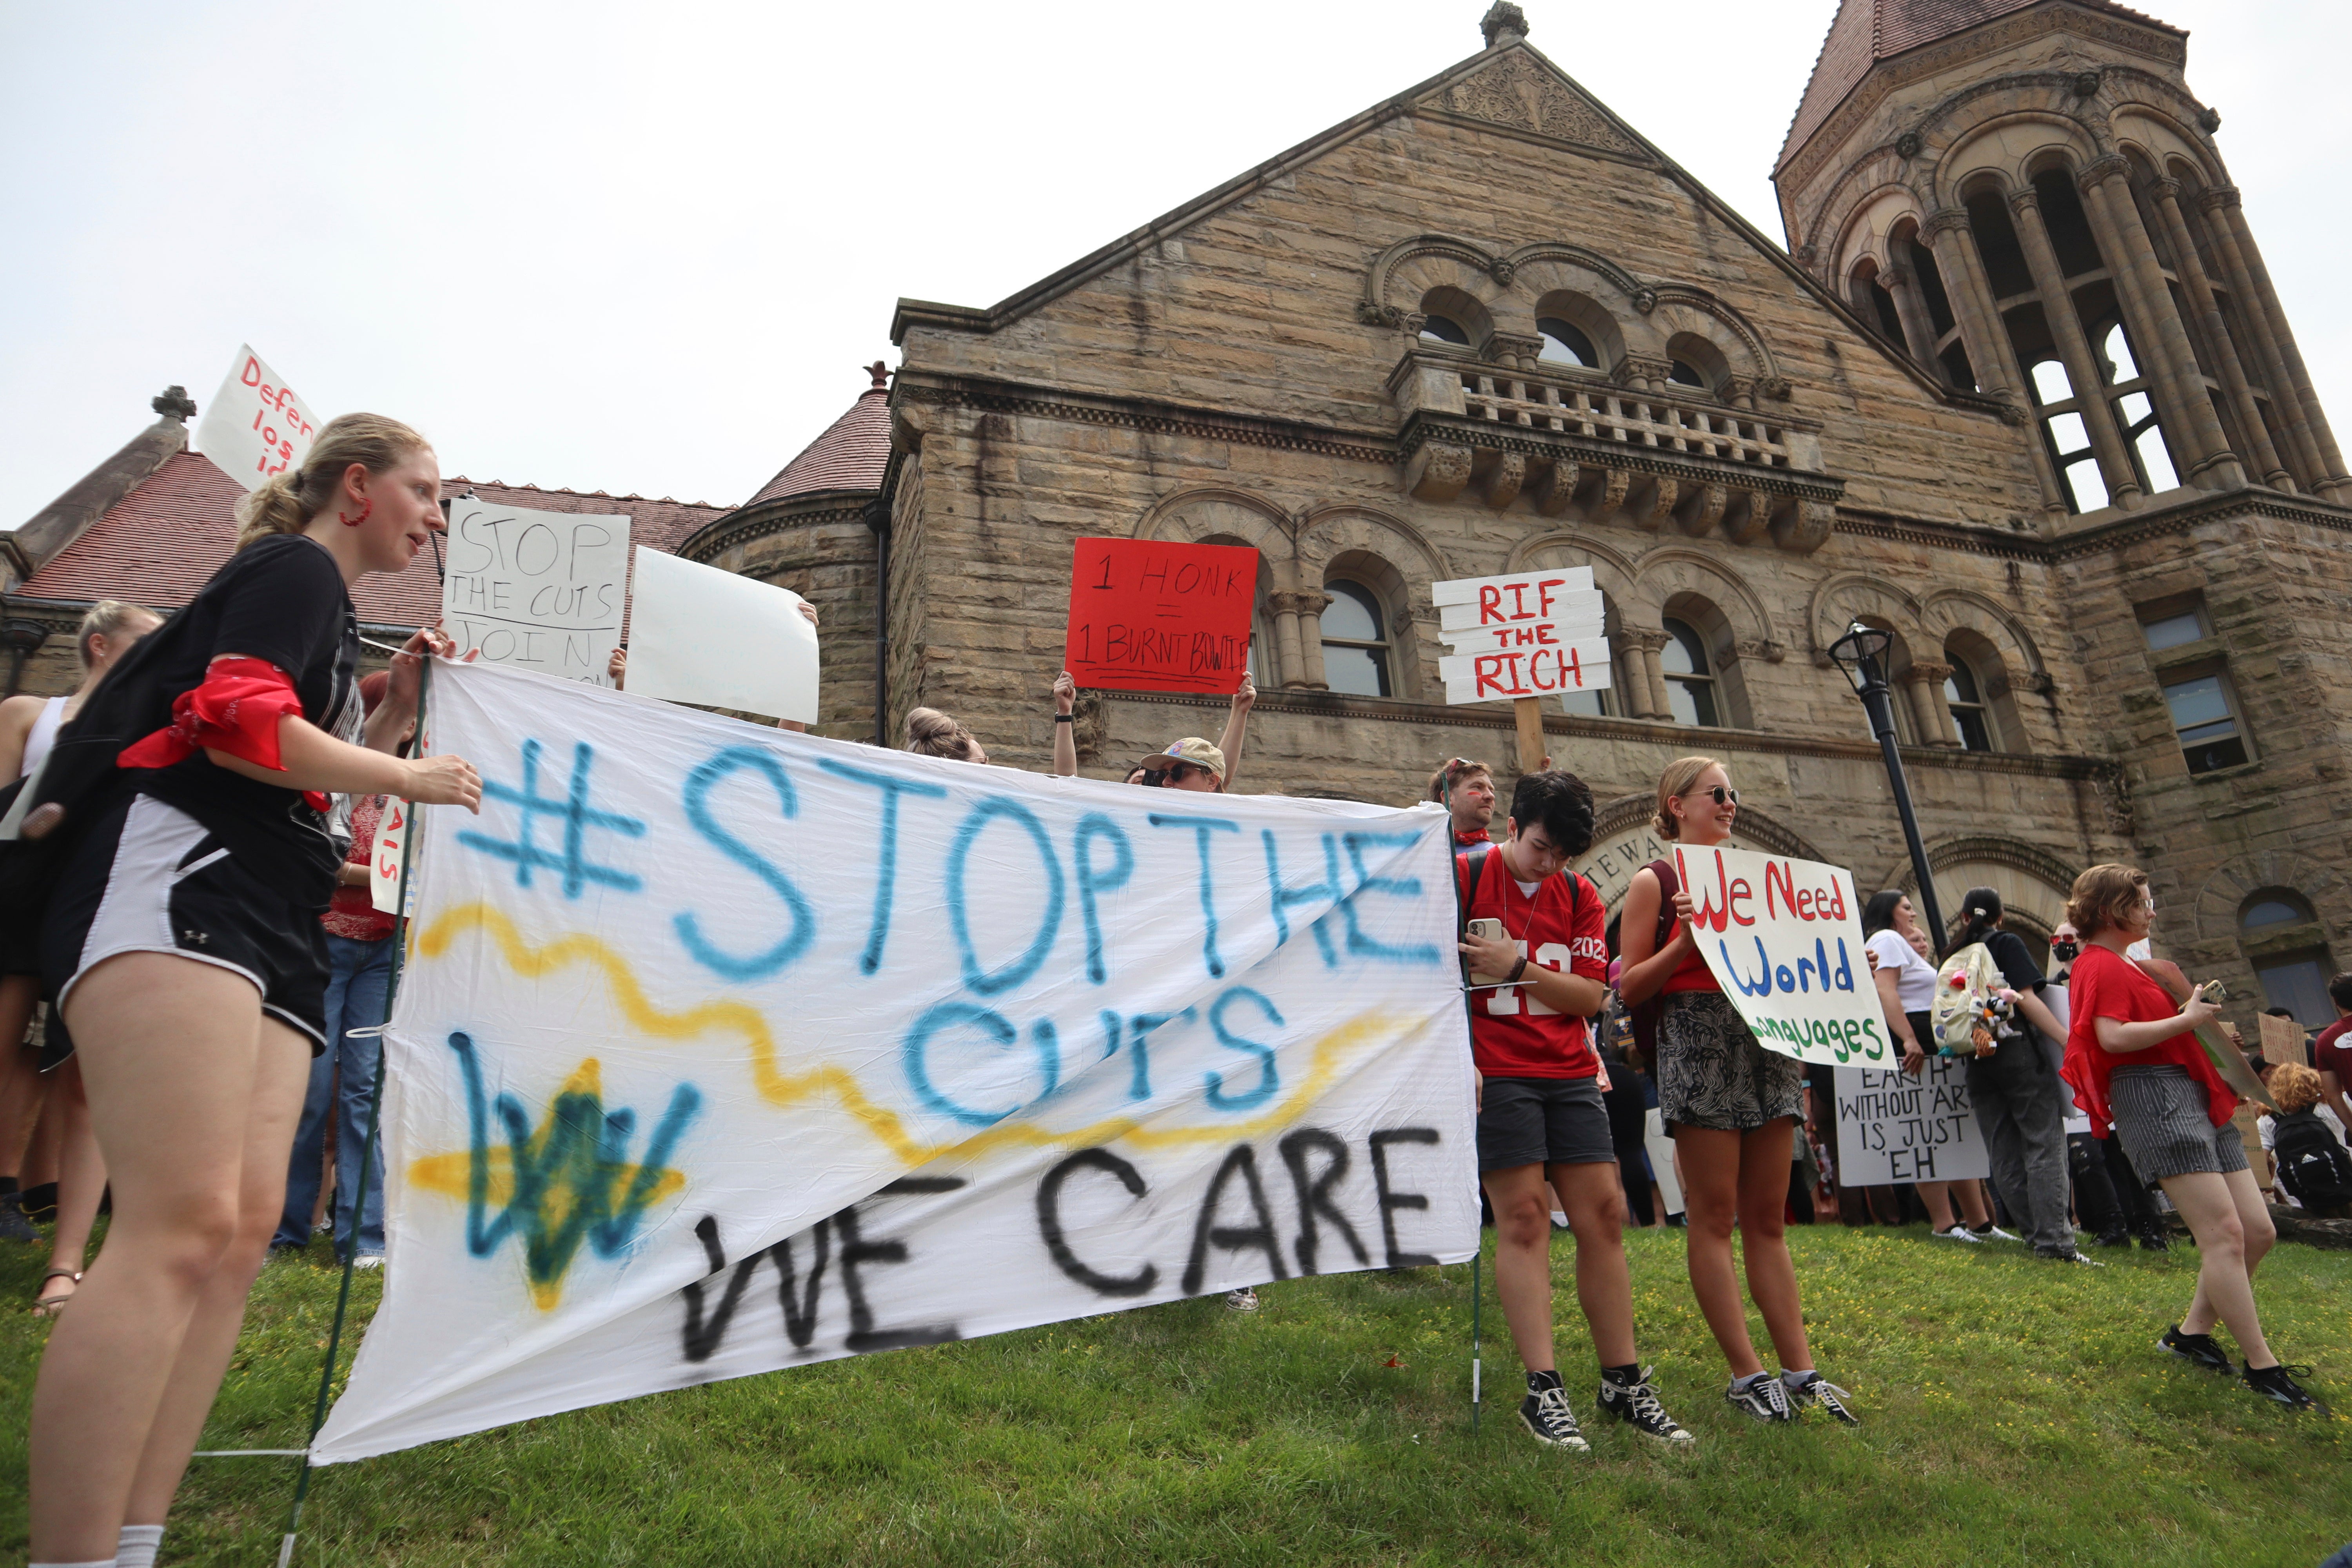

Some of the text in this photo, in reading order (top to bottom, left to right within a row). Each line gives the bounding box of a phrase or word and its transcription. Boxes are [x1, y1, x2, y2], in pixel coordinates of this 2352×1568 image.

[252, 408, 295, 463] los
[455, 512, 611, 581] STOP
[450, 576, 613, 620] THE CUTS
[1093, 554, 1243, 597] 1 HONK
[1479, 579, 1566, 624] RIF
[454, 619, 590, 666] JOIN
[1074, 624, 1096, 664] 1
[1106, 624, 1188, 666] BURNT
[1493, 624, 1559, 648] THE
[1475, 648, 1583, 698] RICH
[1675, 848, 1846, 933] We Need
[1719, 936, 1854, 997] World
[900, 983, 1287, 1127] CUTS
[1839, 1084, 1974, 1122] WITHOUT 'AR
[1861, 1114, 1969, 1150] IS JUST
[681, 1127, 1441, 1364] WE CARE
